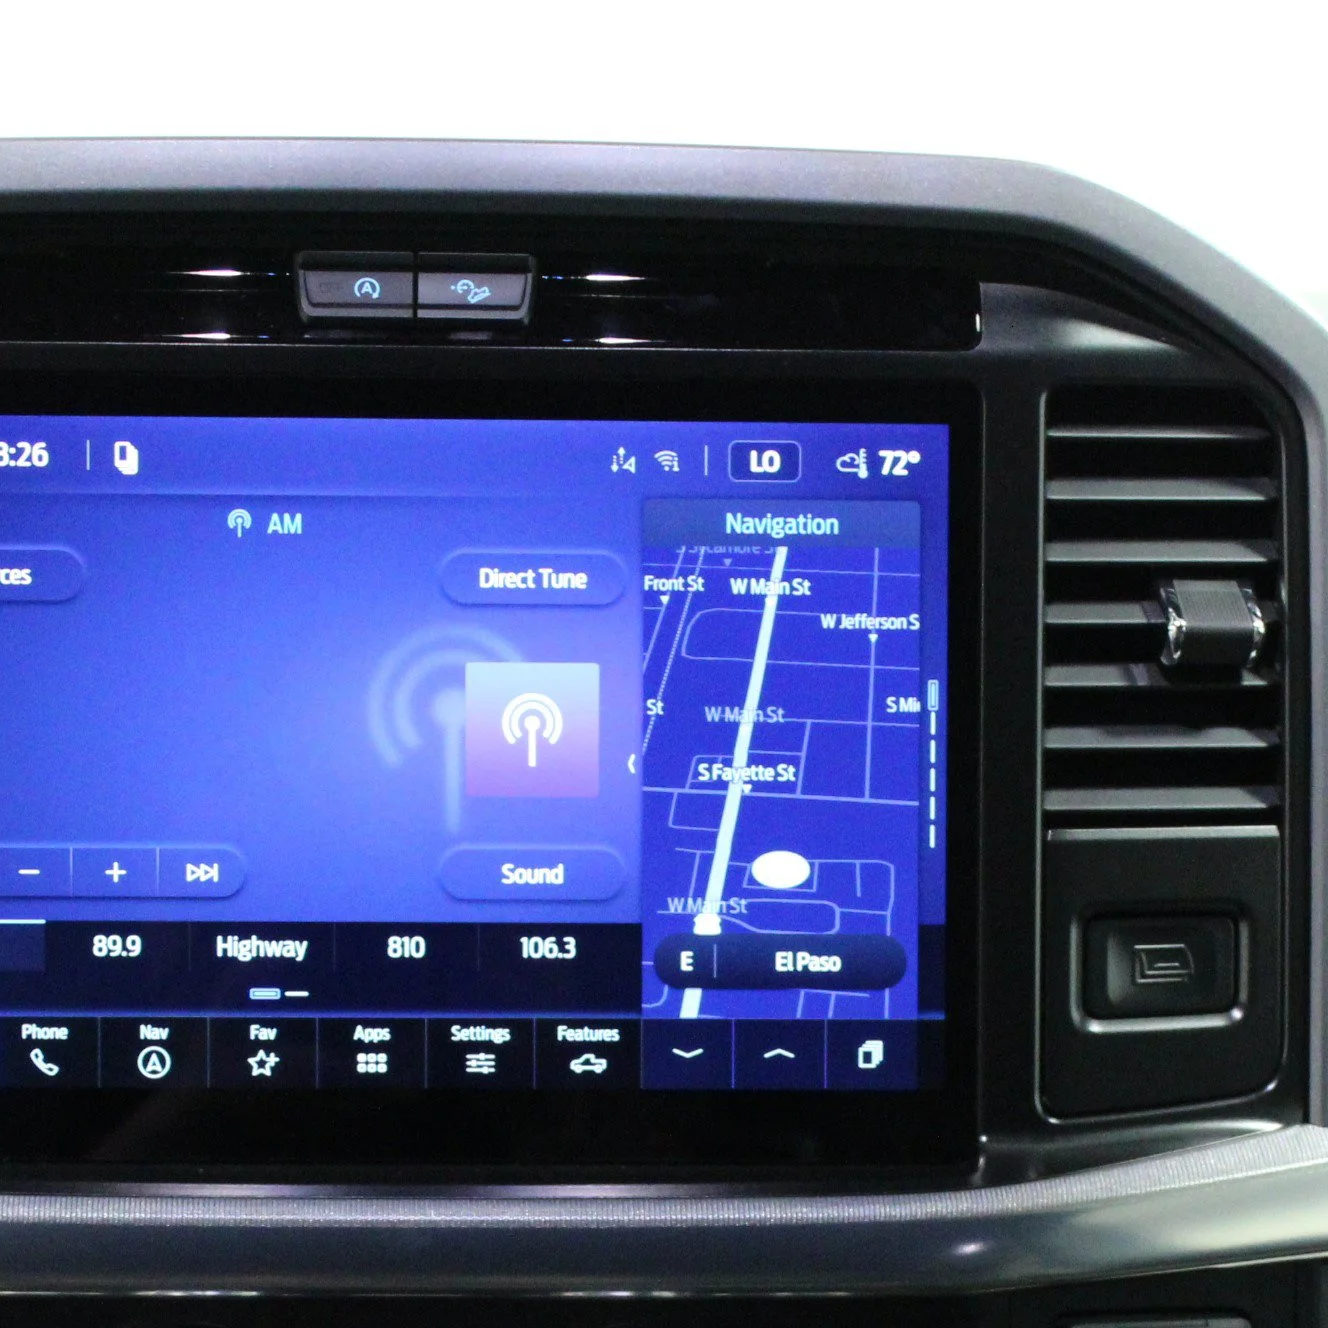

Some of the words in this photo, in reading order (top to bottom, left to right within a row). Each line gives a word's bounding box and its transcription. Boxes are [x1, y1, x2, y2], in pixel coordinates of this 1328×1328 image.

[749, 449, 782, 474] LO
[266, 512, 303, 535] AM
[725, 512, 840, 539] Navigation
[478, 567, 537, 590] Direct
[537, 567, 589, 590] Tune
[642, 573, 685, 592] Front
[685, 573, 705, 593] St
[729, 577, 749, 596] W
[750, 577, 790, 596] Main
[791, 578, 812, 597] St
[820, 613, 840, 631] W
[839, 613, 908, 631] Jefferson
[704, 706, 723, 724] W
[724, 706, 764, 724] Main
[766, 706, 786, 724] St
[885, 697, 898, 714] S
[696, 763, 711, 781] S
[712, 763, 775, 782] Fayette
[775, 763, 797, 783] St
[500, 862, 565, 885] Sound
[666, 896, 685, 914] W
[728, 896, 749, 914] St
[92, 934, 142, 958] 89.9
[216, 934, 309, 962] Highway
[386, 935, 426, 959] 810
[519, 936, 577, 960] 106.3
[679, 950, 694, 972] E
[775, 951, 794, 972] El
[795, 950, 842, 974] Paso
[21, 1023, 69, 1041] Phone
[139, 1023, 170, 1041] Nav
[249, 1023, 278, 1041] Fav
[352, 1024, 392, 1044] Apps
[450, 1024, 512, 1045] Settings
[556, 1024, 621, 1042] Features
